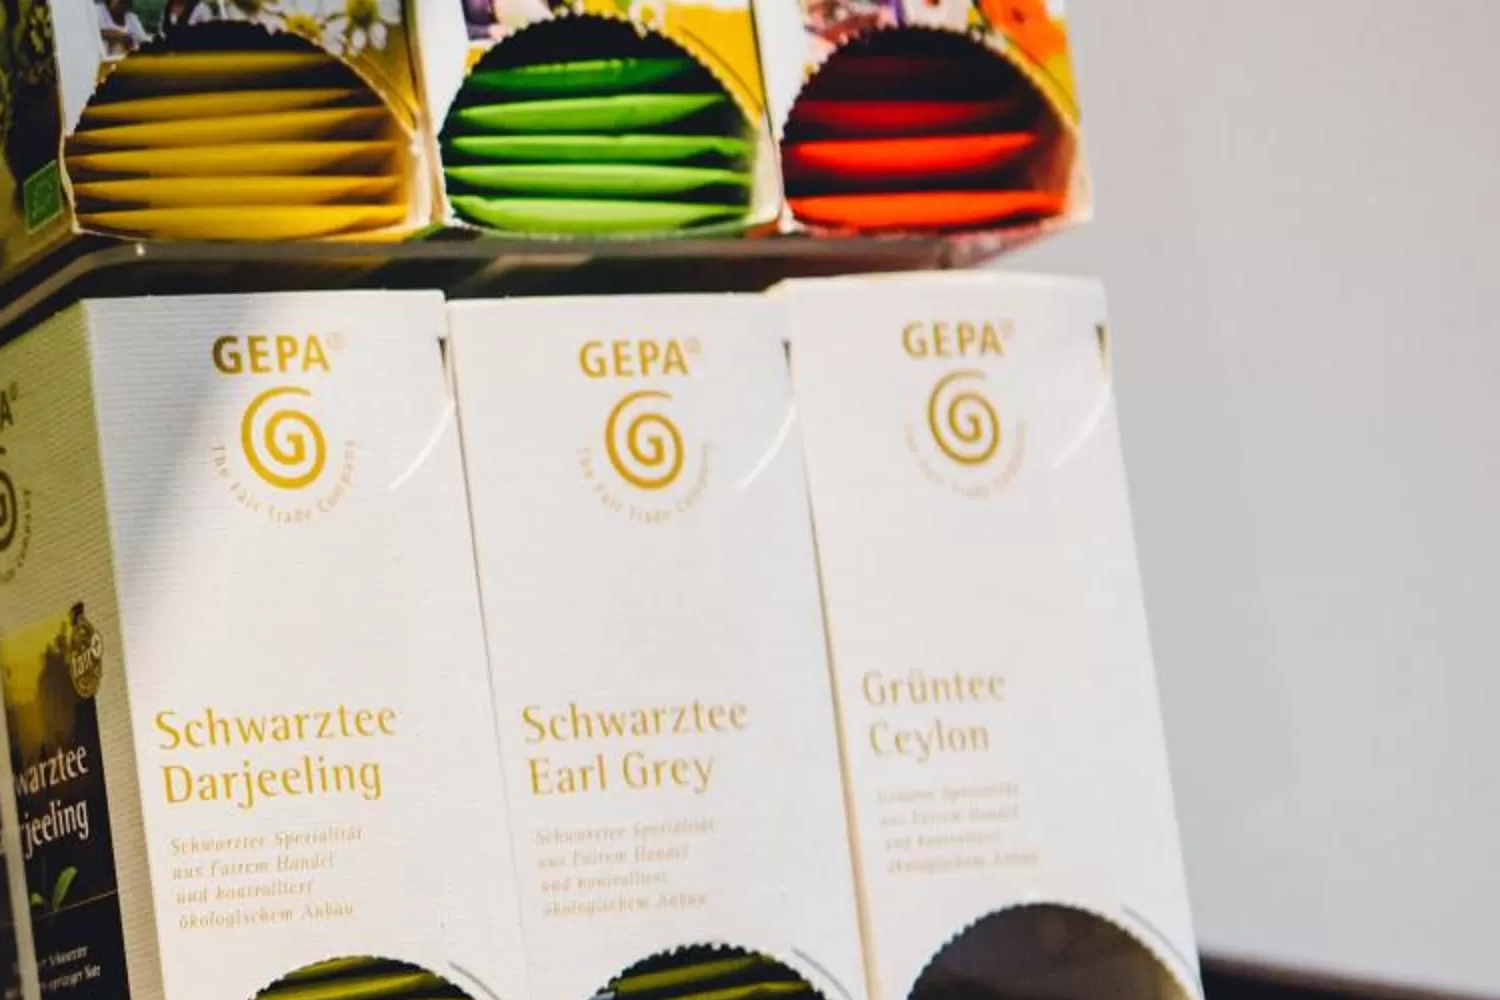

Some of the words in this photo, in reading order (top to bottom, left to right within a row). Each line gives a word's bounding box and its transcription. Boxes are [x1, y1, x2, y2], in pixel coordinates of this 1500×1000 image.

[862, 668, 1005, 707] Grüntee
[154, 703, 397, 750] Schwarztee
[522, 699, 749, 744] Schwarztee
[869, 717, 990, 765] Ceylon
[161, 755, 383, 810] Darjeeling
[529, 752, 609, 797] Earl
[622, 750, 714, 795] Grey
